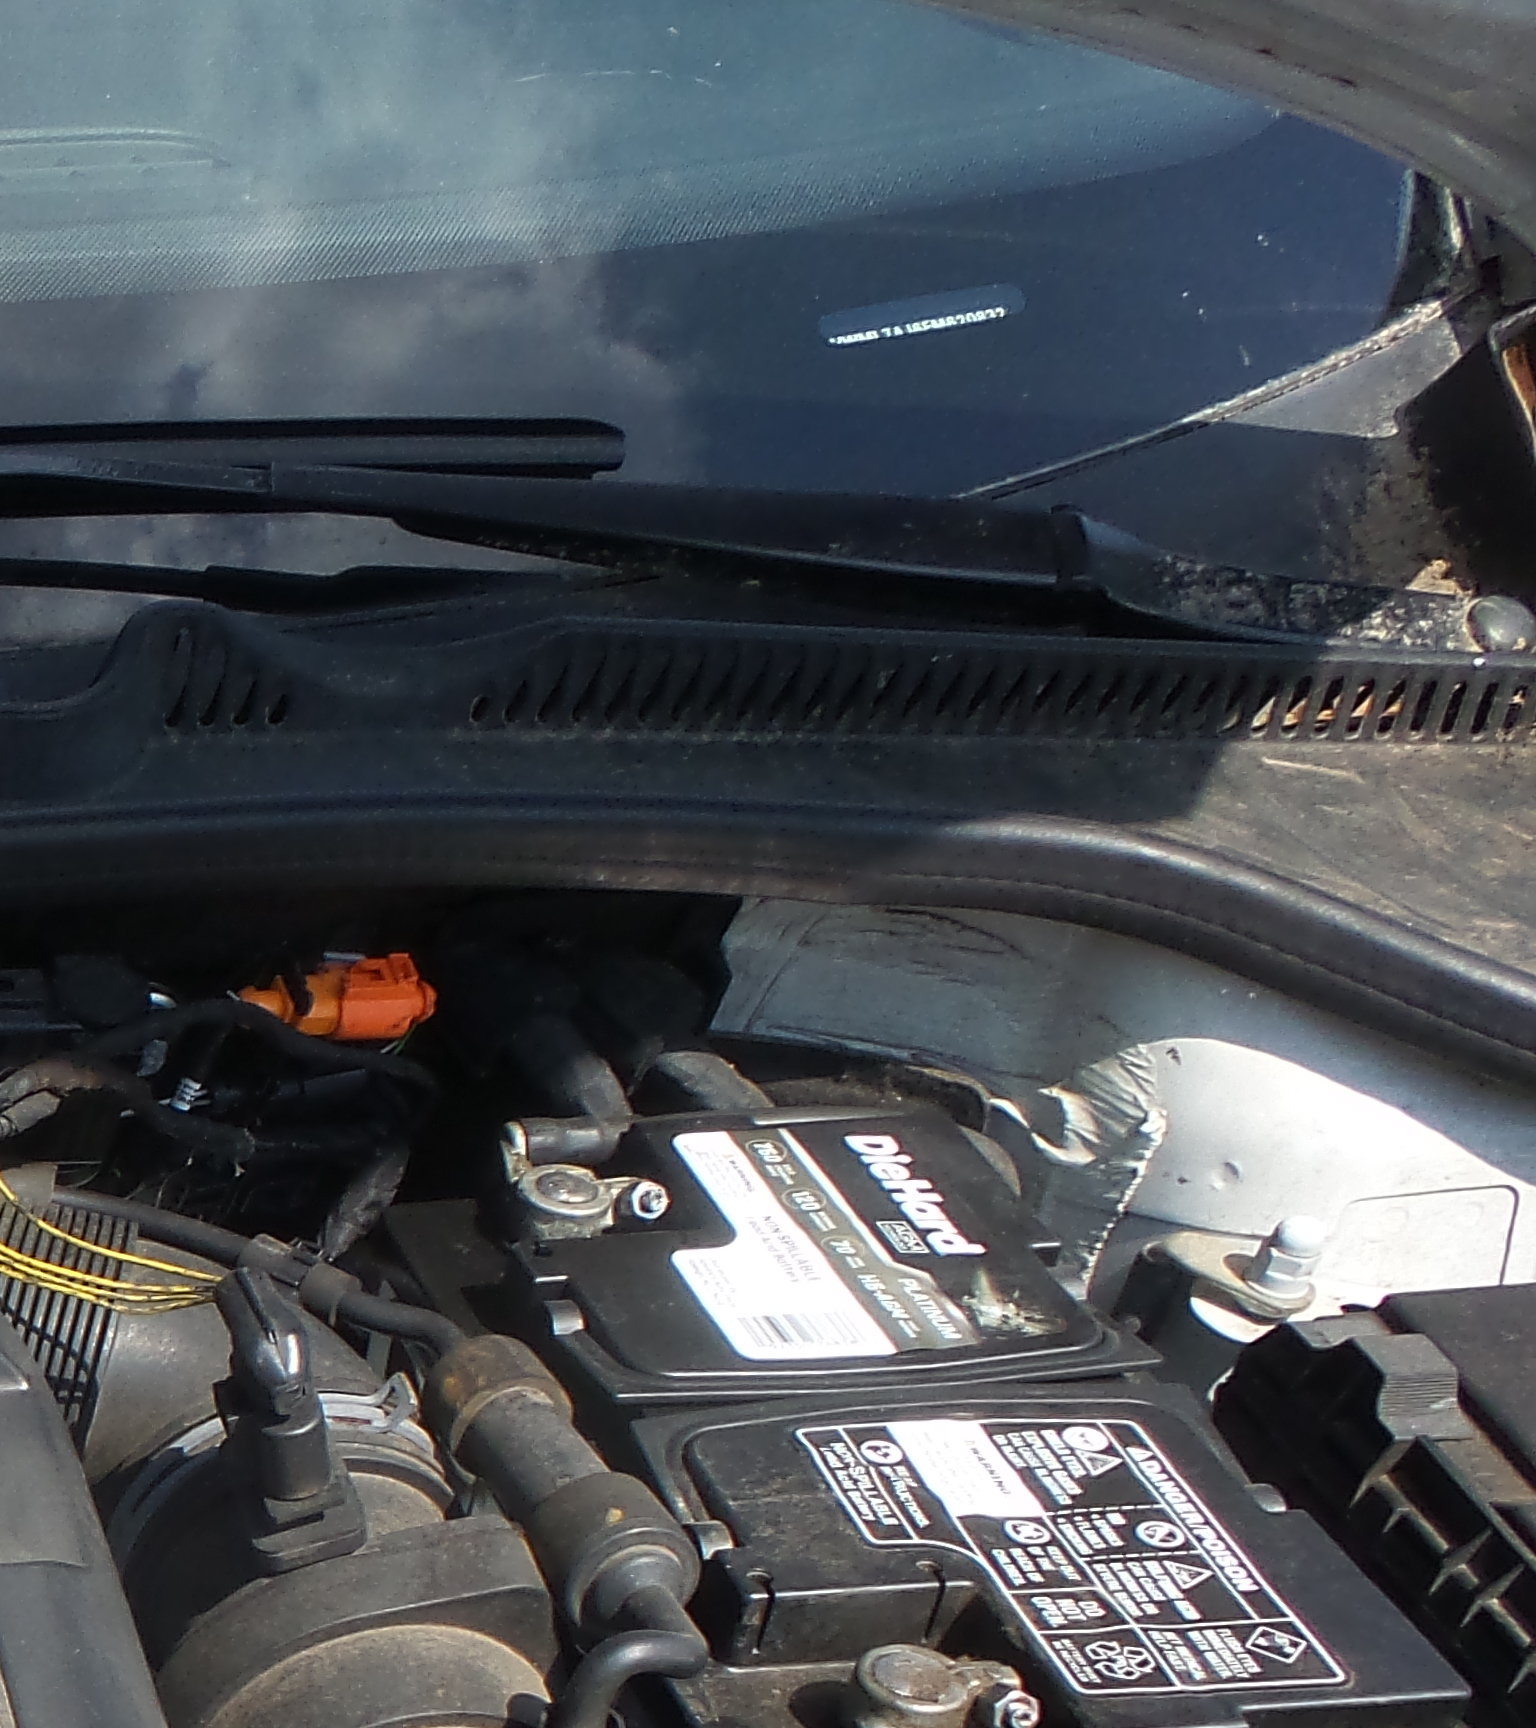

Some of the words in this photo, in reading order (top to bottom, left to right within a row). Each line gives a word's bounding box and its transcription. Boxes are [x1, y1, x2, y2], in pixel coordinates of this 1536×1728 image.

[791, 1190, 821, 1211] 120
[844, 1134, 988, 1257] DieHard
[898, 1277, 962, 1340] PLATINUM
[1137, 1459, 1261, 1593] DANGER/POISON
[1054, 1598, 1088, 1621] NOT
[1077, 1600, 1107, 1617] DO
